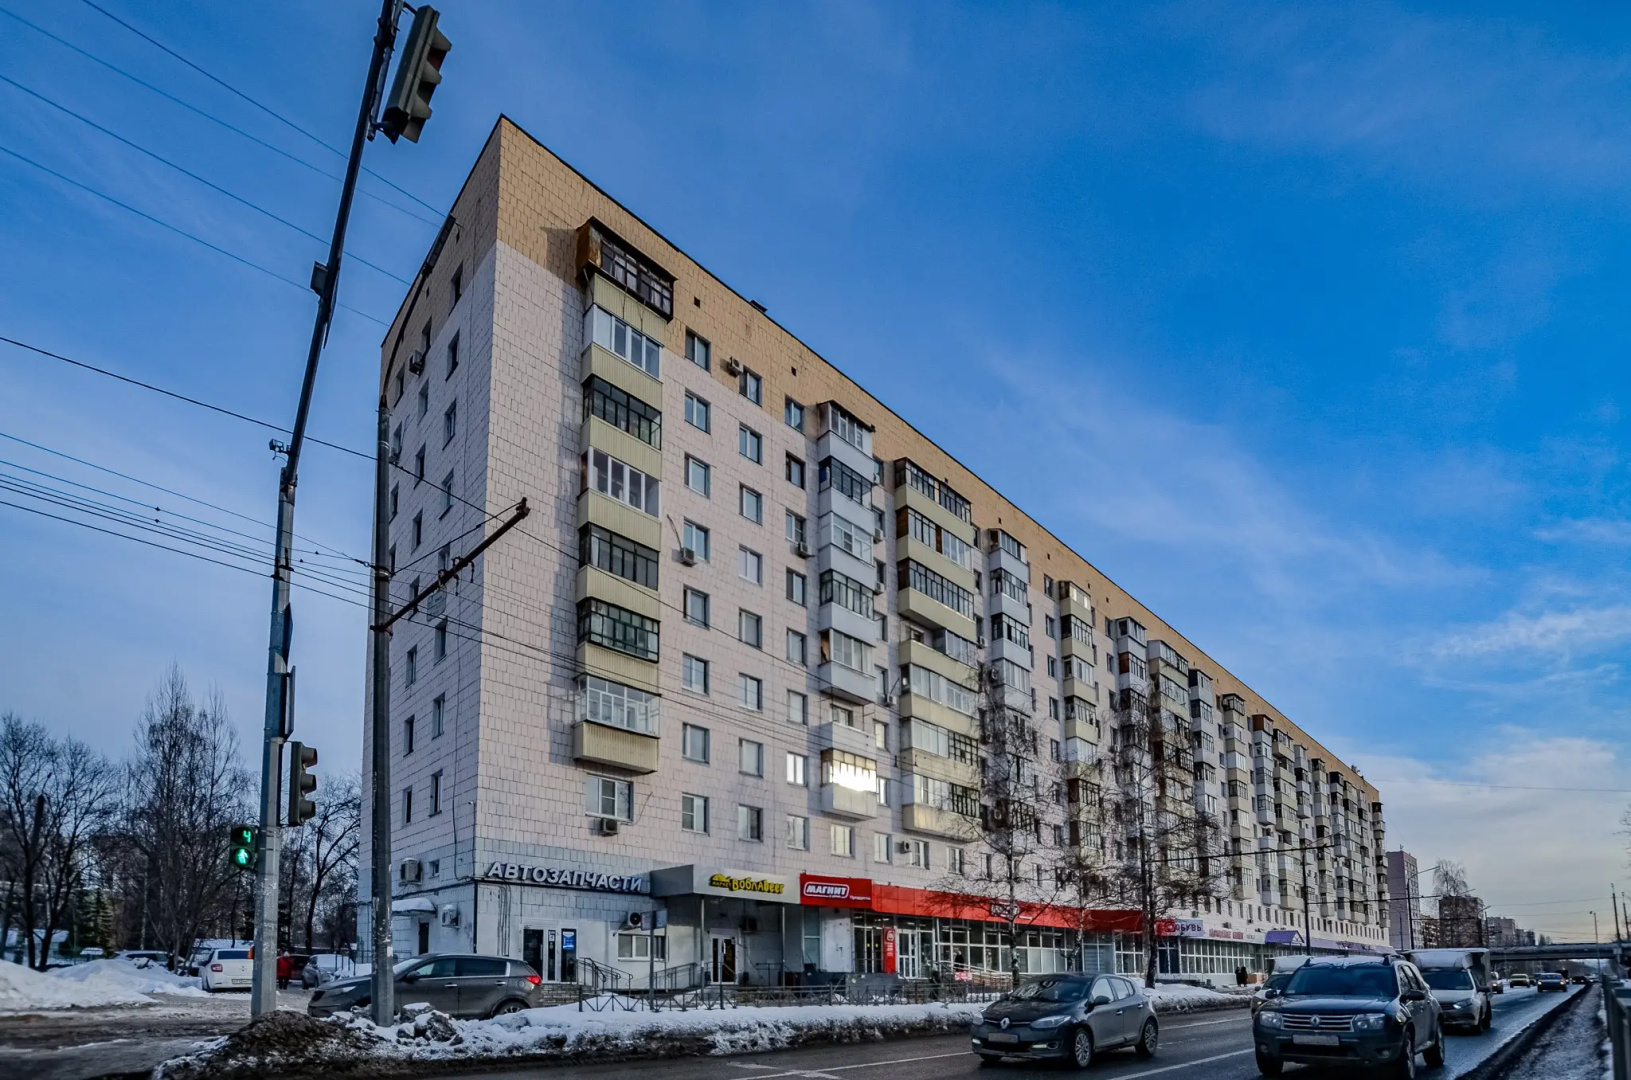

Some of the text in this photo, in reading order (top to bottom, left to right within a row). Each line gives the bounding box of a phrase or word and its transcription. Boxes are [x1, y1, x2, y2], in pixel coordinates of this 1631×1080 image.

[243, 830, 251, 843] 4
[487, 861, 643, 893] АВТОЗАПЧАСТИ
[806, 885, 847, 896] МАГНИТ
[1175, 923, 1202, 932] ОБУВЬ
